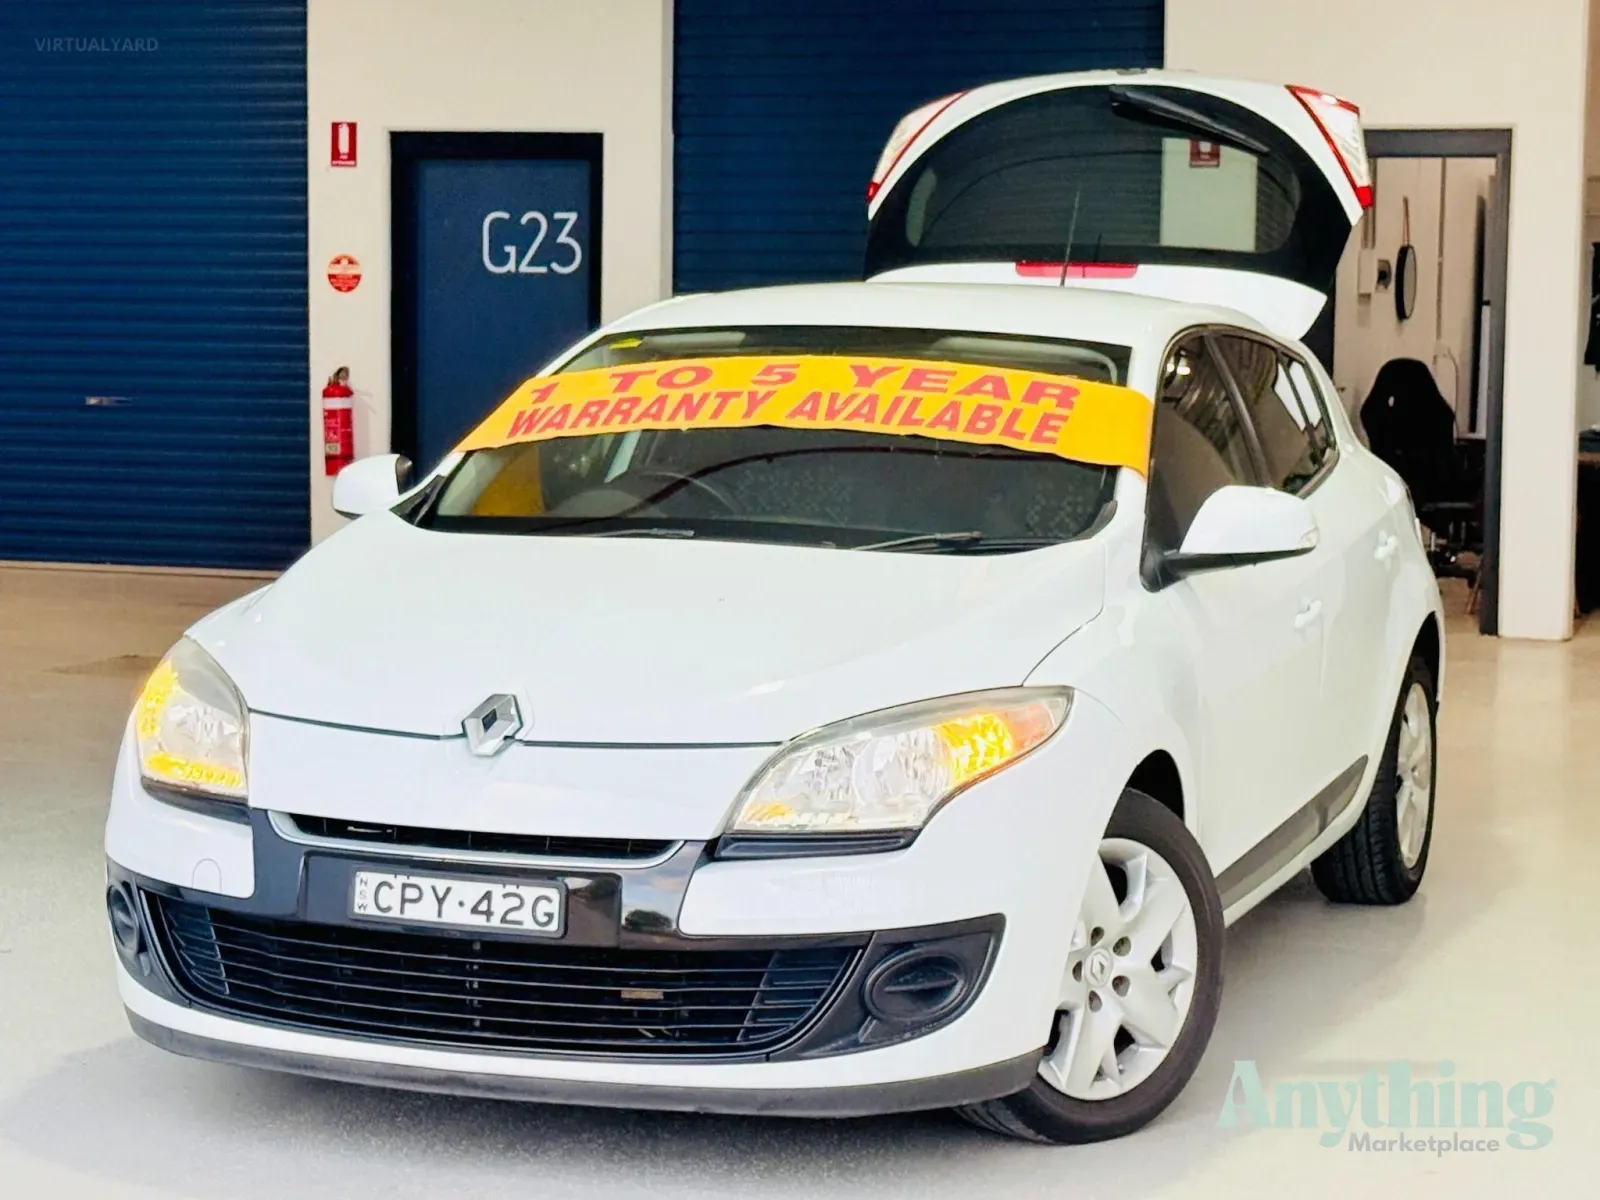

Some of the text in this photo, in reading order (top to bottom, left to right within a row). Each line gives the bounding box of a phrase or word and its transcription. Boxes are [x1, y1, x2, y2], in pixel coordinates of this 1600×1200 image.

[481, 211, 583, 274] G23
[530, 363, 1081, 411] 1 TO 5 YEAR
[507, 389, 1070, 444] WARRANTY AVAILABLE
